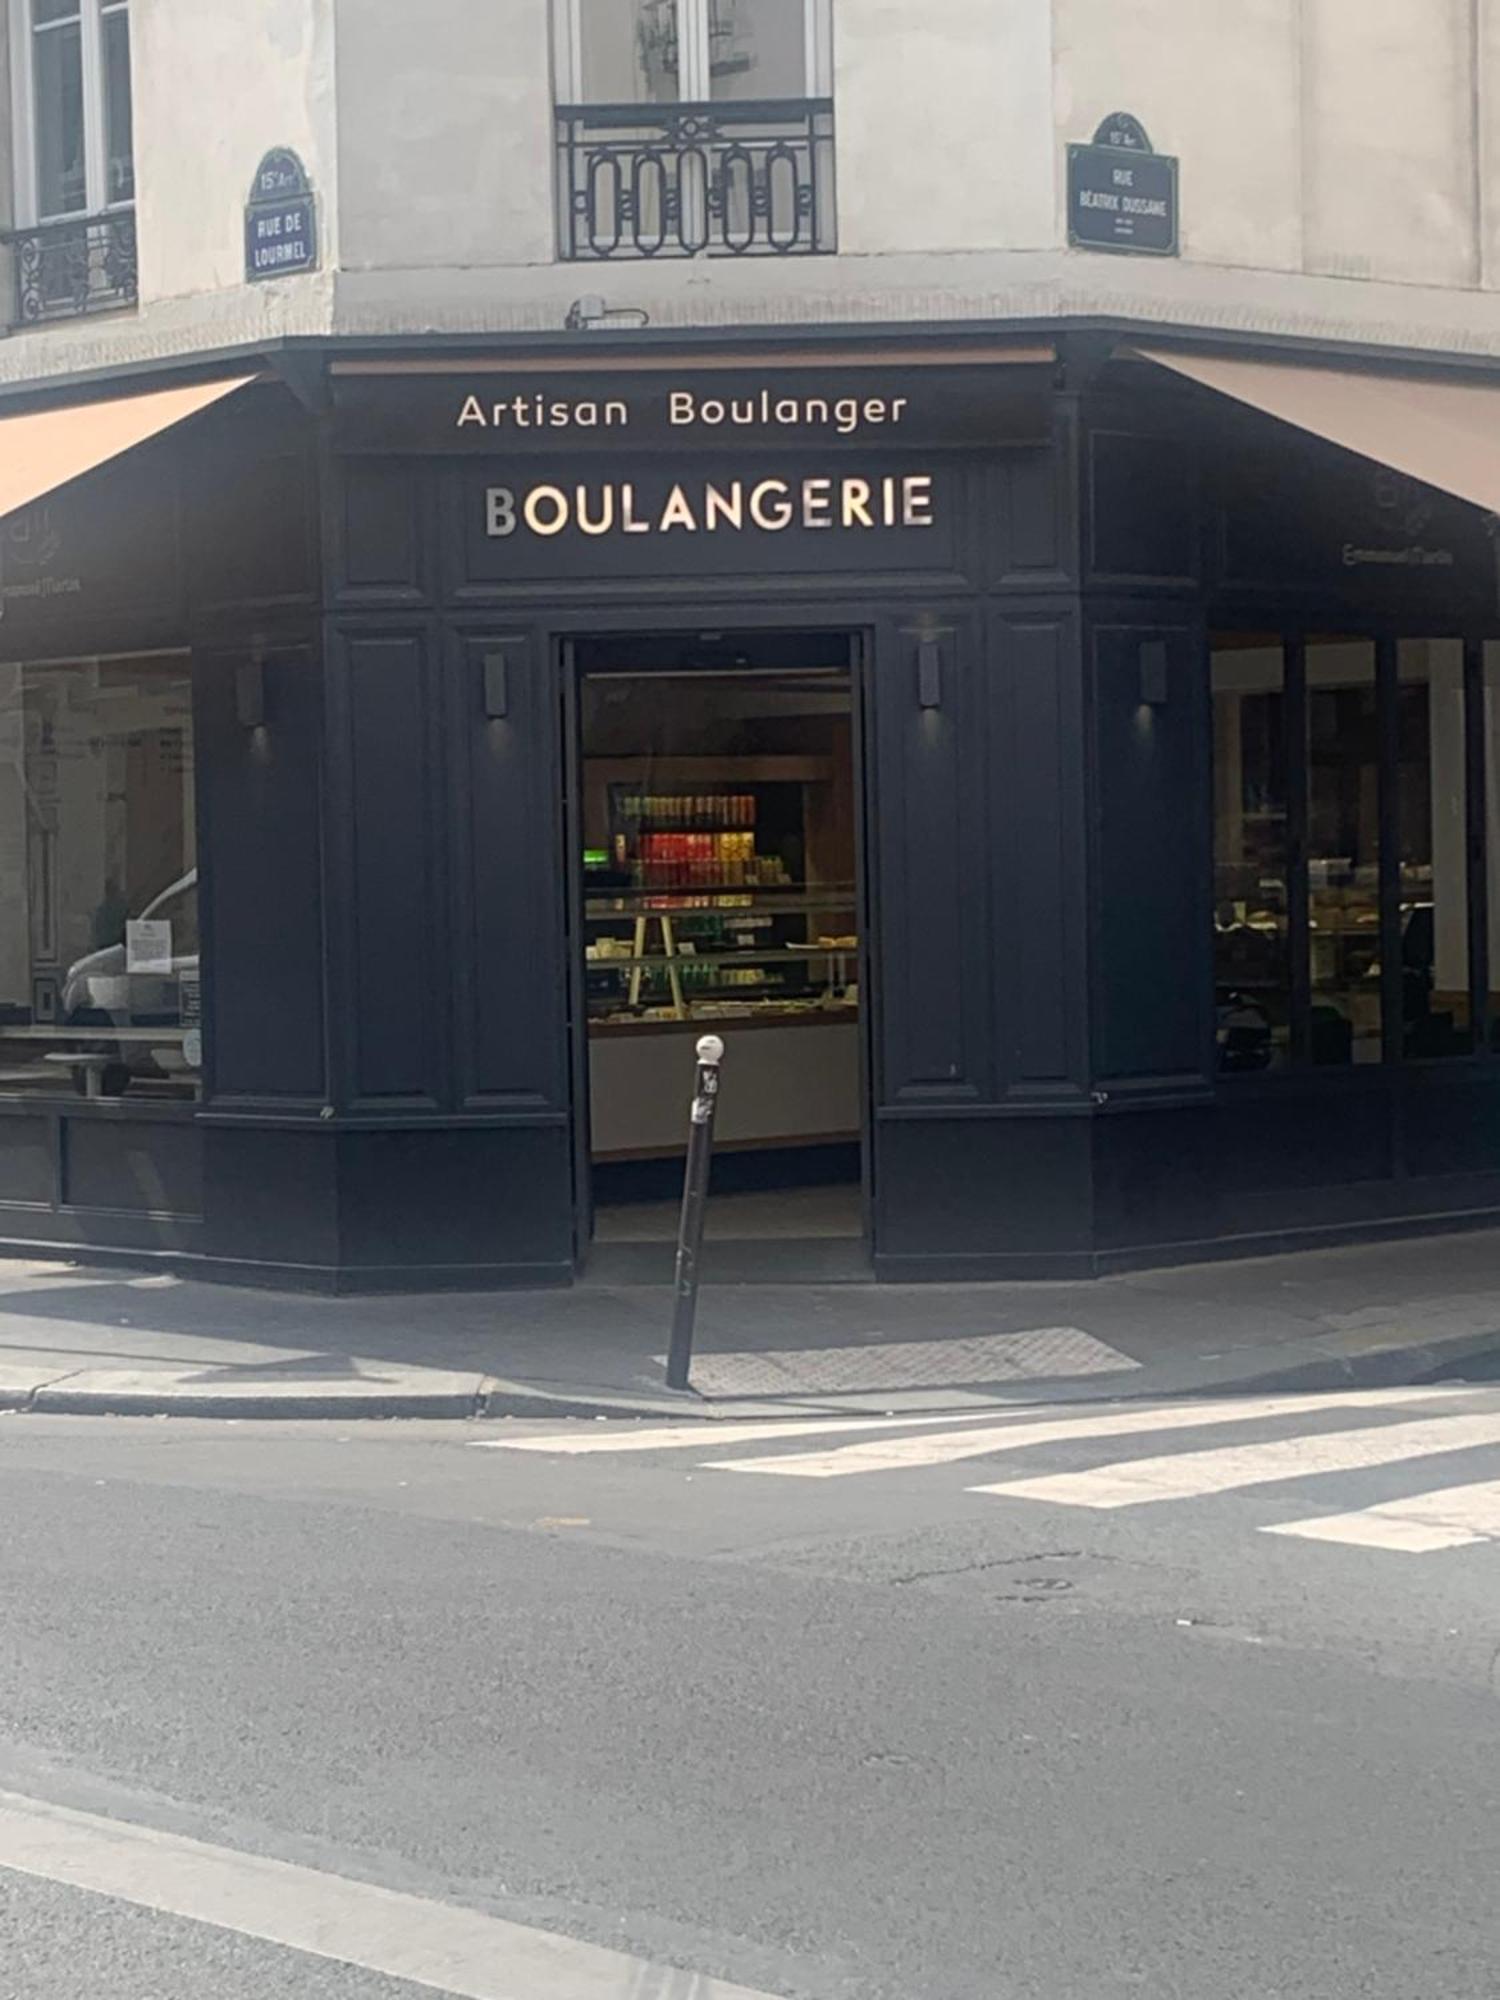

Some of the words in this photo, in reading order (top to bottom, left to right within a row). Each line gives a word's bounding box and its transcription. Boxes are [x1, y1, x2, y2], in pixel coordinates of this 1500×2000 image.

[1112, 169, 1133, 186] RUE
[257, 216, 281, 238] RUE
[285, 213, 302, 233] DE
[255, 241, 305, 267] LOURMEL
[457, 394, 627, 427] Artisan
[669, 389, 907, 433] Boulanger
[486, 476, 933, 536] BOULANGERIE
